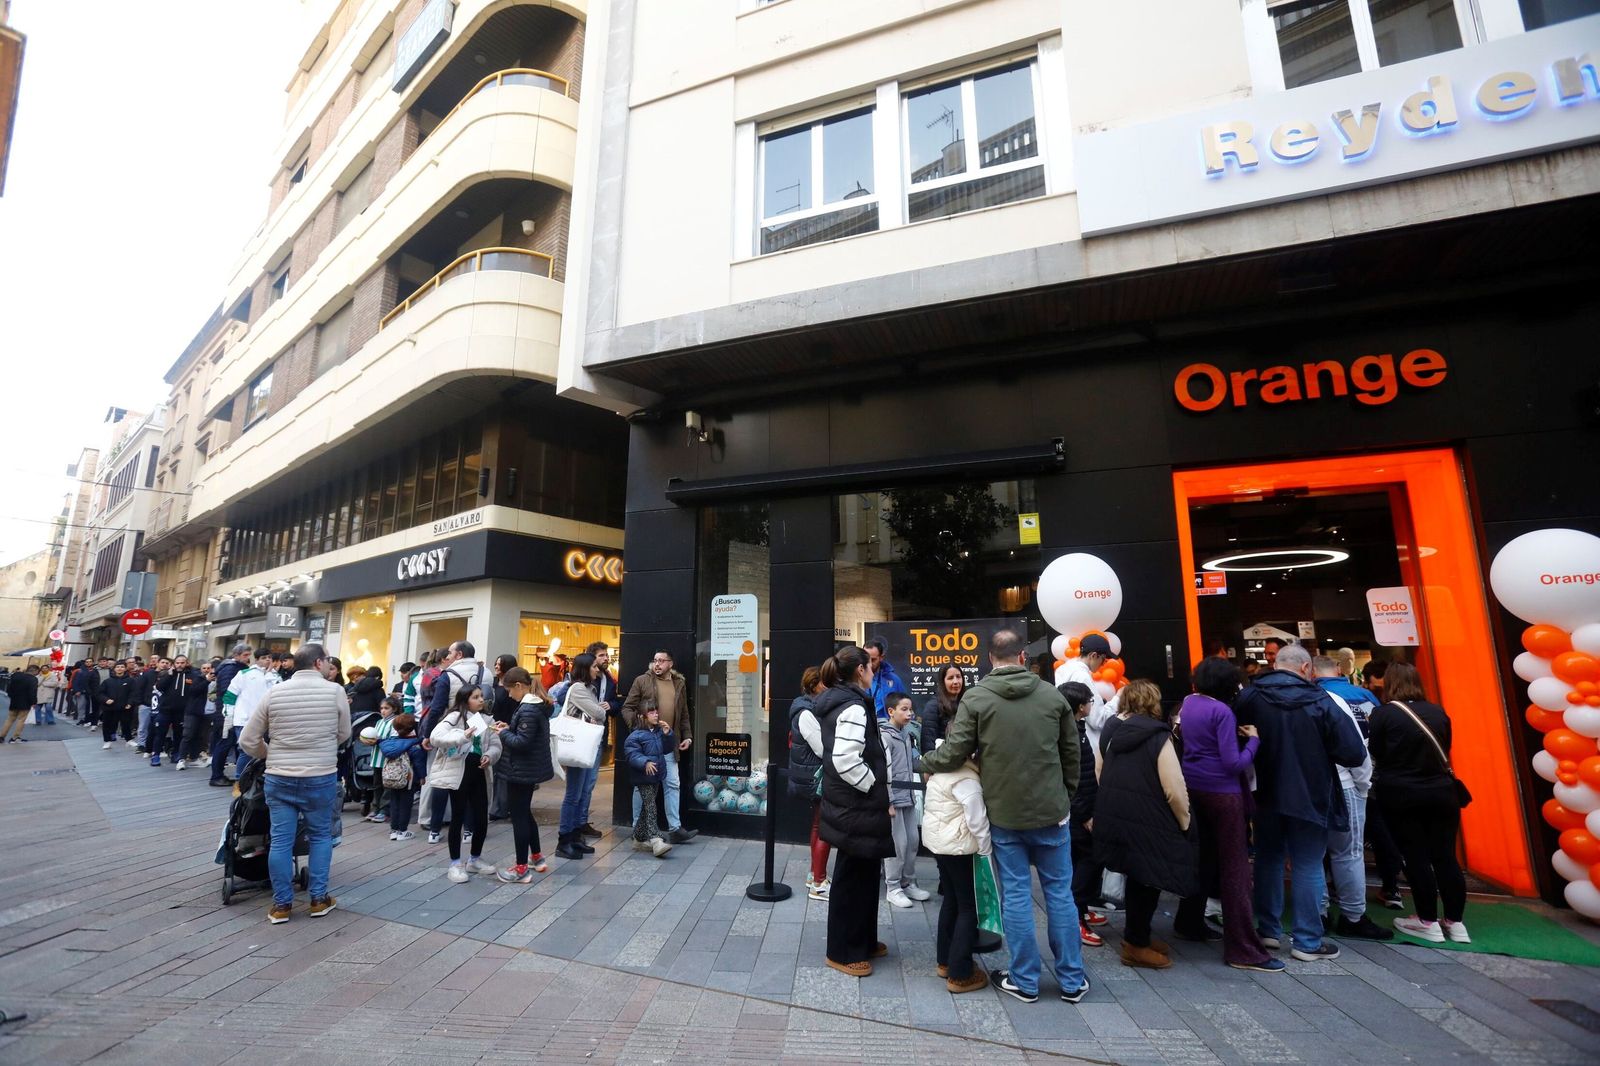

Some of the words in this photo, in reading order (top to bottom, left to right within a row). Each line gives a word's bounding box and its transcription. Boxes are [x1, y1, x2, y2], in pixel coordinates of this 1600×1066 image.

[1201, 51, 1600, 175] Reyden
[1174, 349, 1448, 412] Orange
[433, 521, 448, 534] SAN
[449, 512, 481, 530] ALVARO
[1074, 589, 1112, 600] Orange
[714, 598, 742, 606] ¿Buscas
[1372, 601, 1408, 612] Todo
[714, 605, 737, 613] ayuda?
[276, 612, 297, 627] Tz
[835, 628, 851, 637] SUNG
[910, 628, 979, 651] Todo
[910, 653, 922, 665] lo
[926, 655, 950, 666] que
[954, 654, 978, 666] soy
[709, 738, 737, 747] ¿Tienes
[709, 747, 742, 756] negocio?
